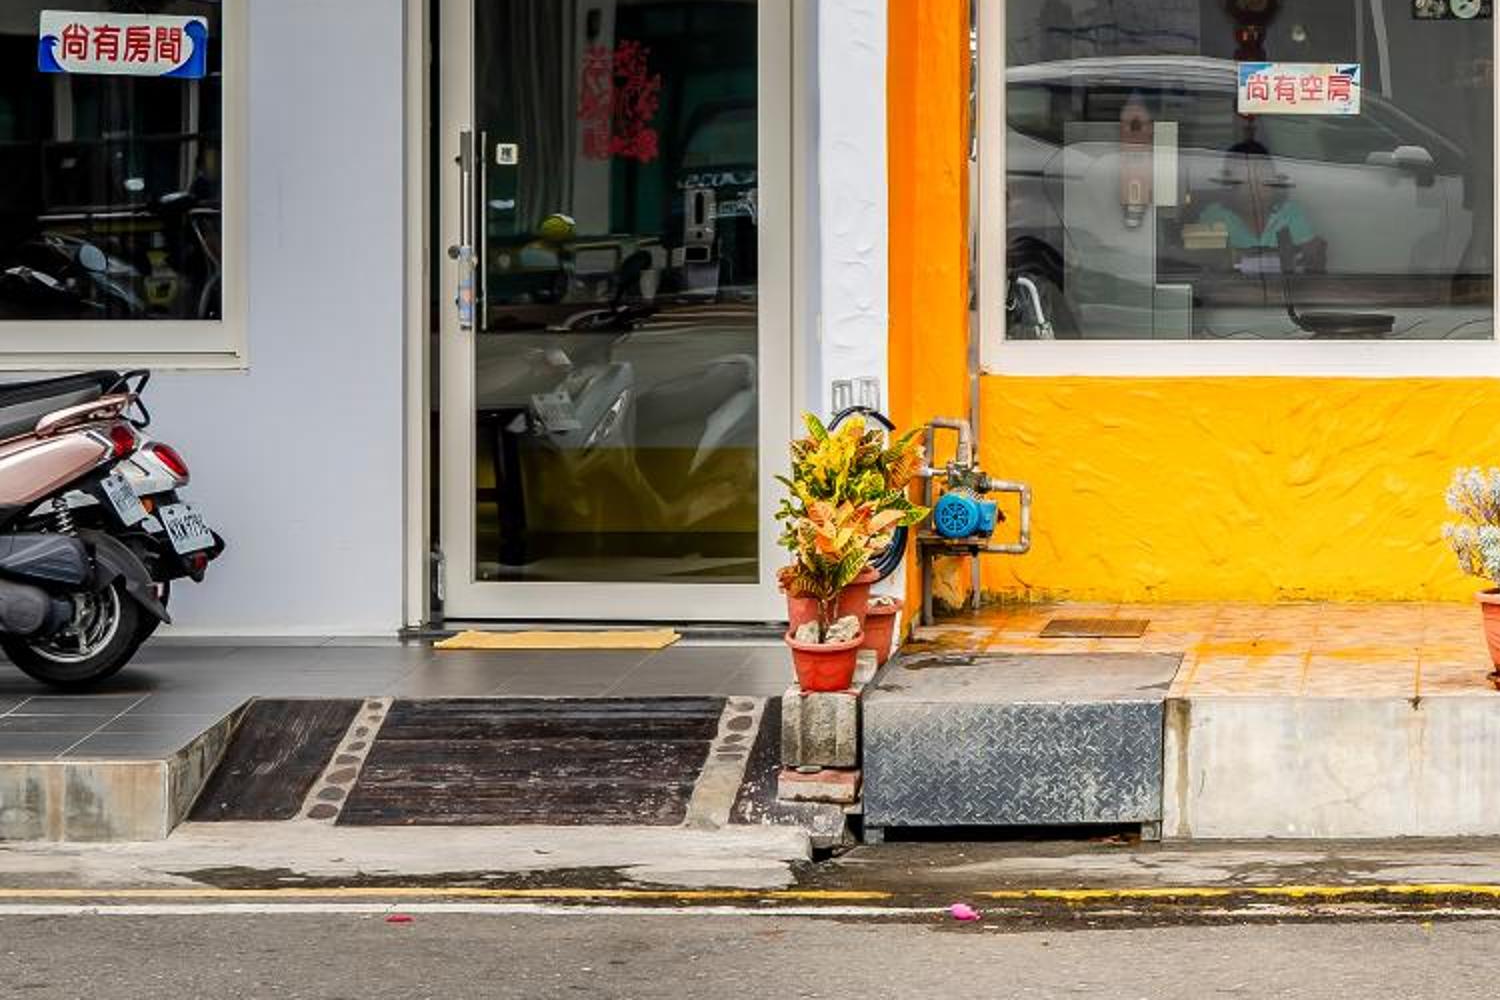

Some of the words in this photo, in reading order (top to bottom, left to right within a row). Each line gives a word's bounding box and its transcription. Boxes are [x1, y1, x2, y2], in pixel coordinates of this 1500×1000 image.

[61, 23, 184, 64] 尚有房間
[1247, 74, 1353, 102] 尚有空房
